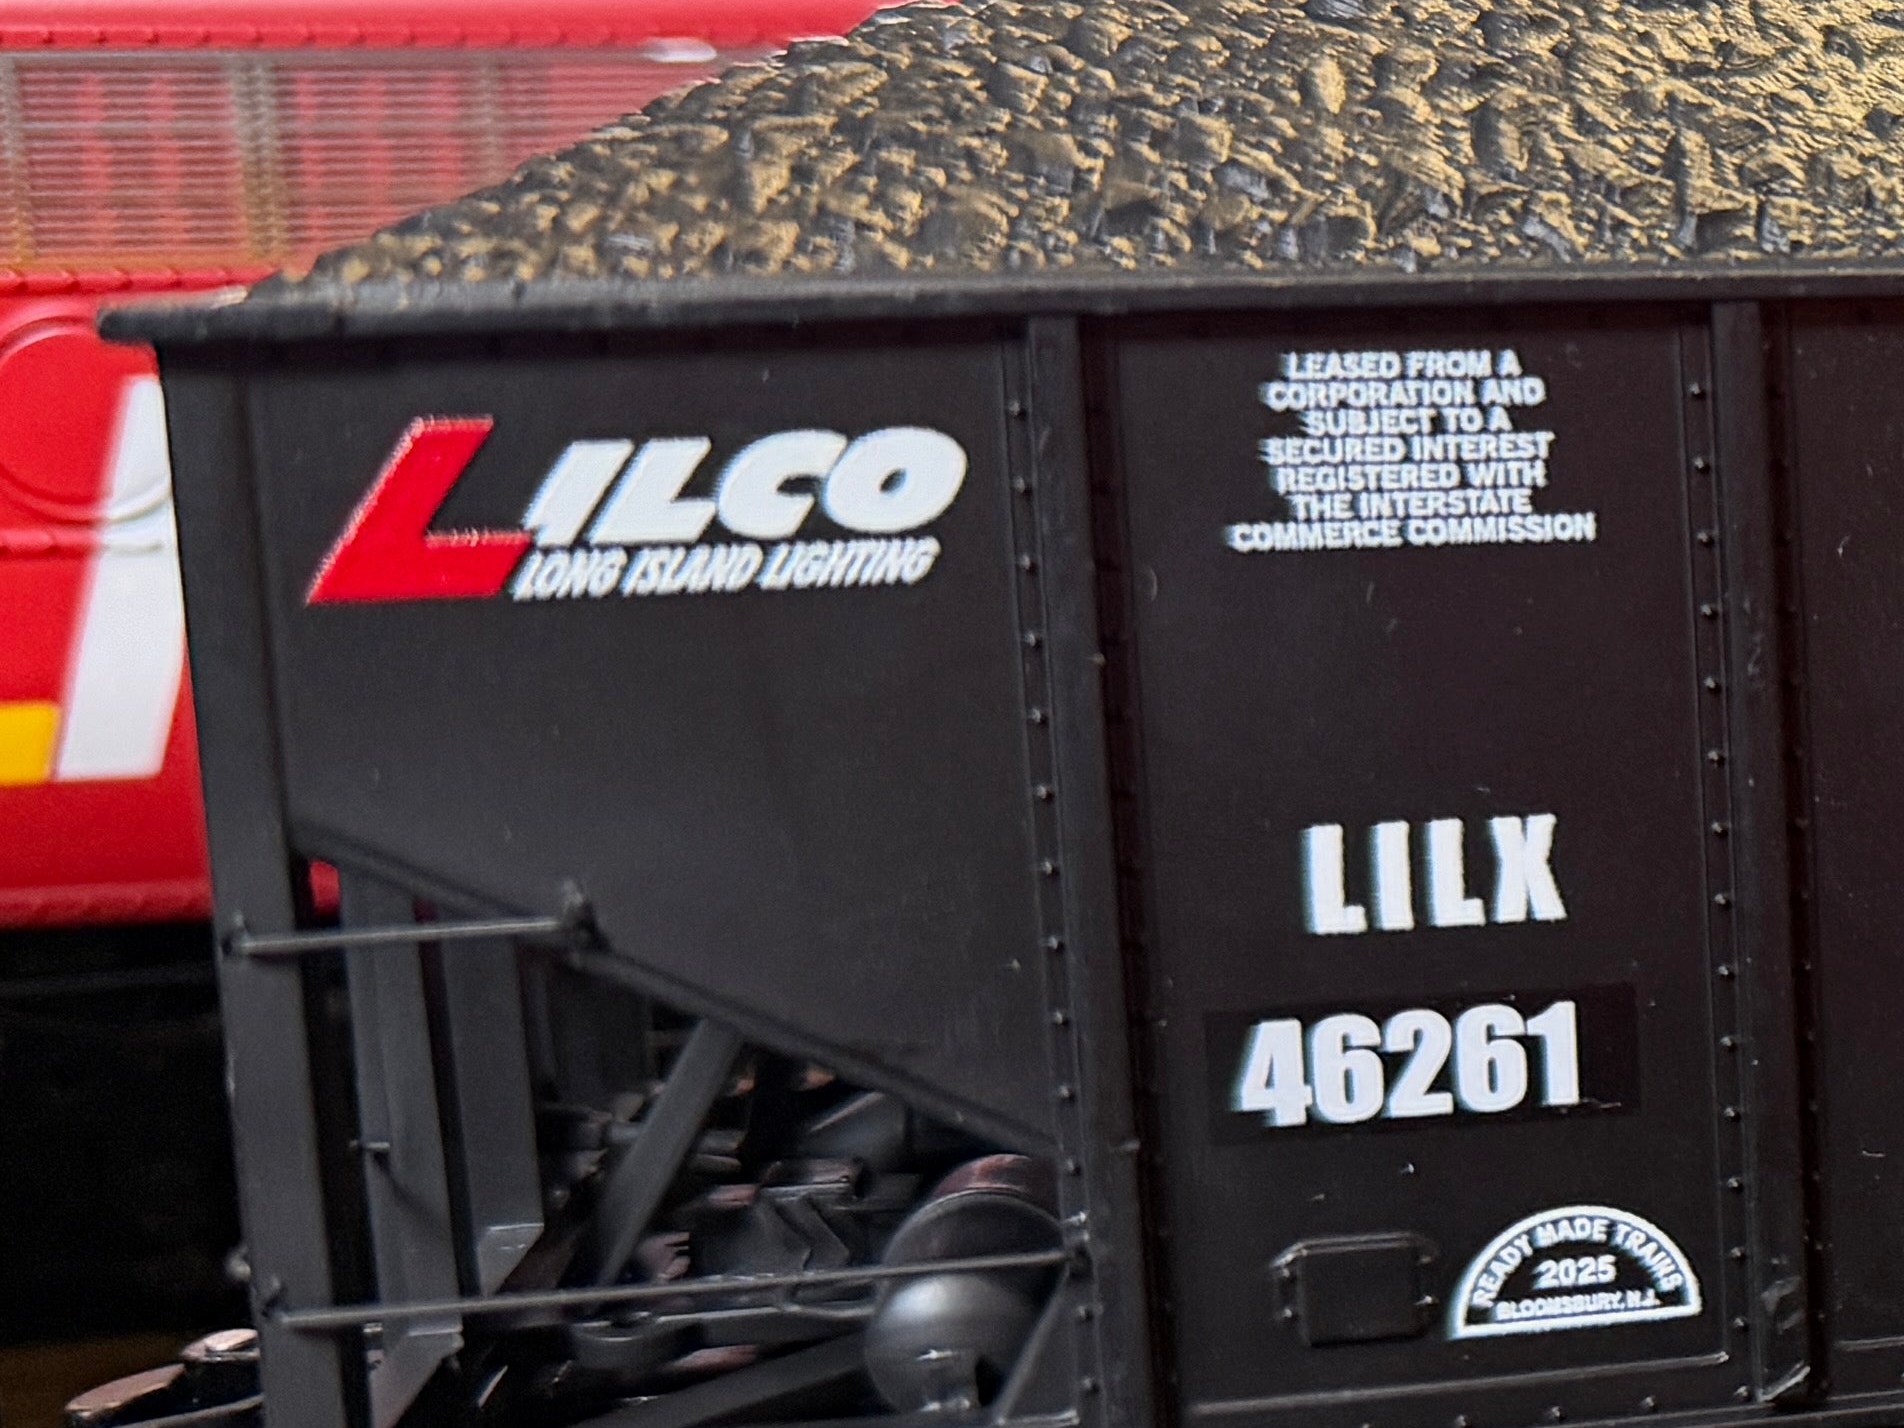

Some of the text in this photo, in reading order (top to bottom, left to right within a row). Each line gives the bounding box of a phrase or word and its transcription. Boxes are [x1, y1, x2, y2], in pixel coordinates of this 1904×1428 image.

[1284, 348, 1522, 379] LEASED FROM A
[1263, 376, 1547, 411] CORPORATION AND
[1302, 406, 1513, 436] SUBJECT TO A
[1263, 431, 1556, 465] SECURED INTEREST
[1275, 459, 1548, 495] REGISTERED WITH
[307, 415, 967, 606] LILCO
[1289, 488, 1532, 521] THE INTERSTATE
[1229, 512, 1597, 553] COMMERCE COMMISSION
[513, 535, 941, 602] LONG ISLAND LIGHTING
[1306, 813, 1567, 935] LILX
[1233, 1000, 1580, 1128] 46261
[1472, 1218, 1686, 1309] READY MADE TRAINS
[1532, 1254, 1618, 1290] 2025
